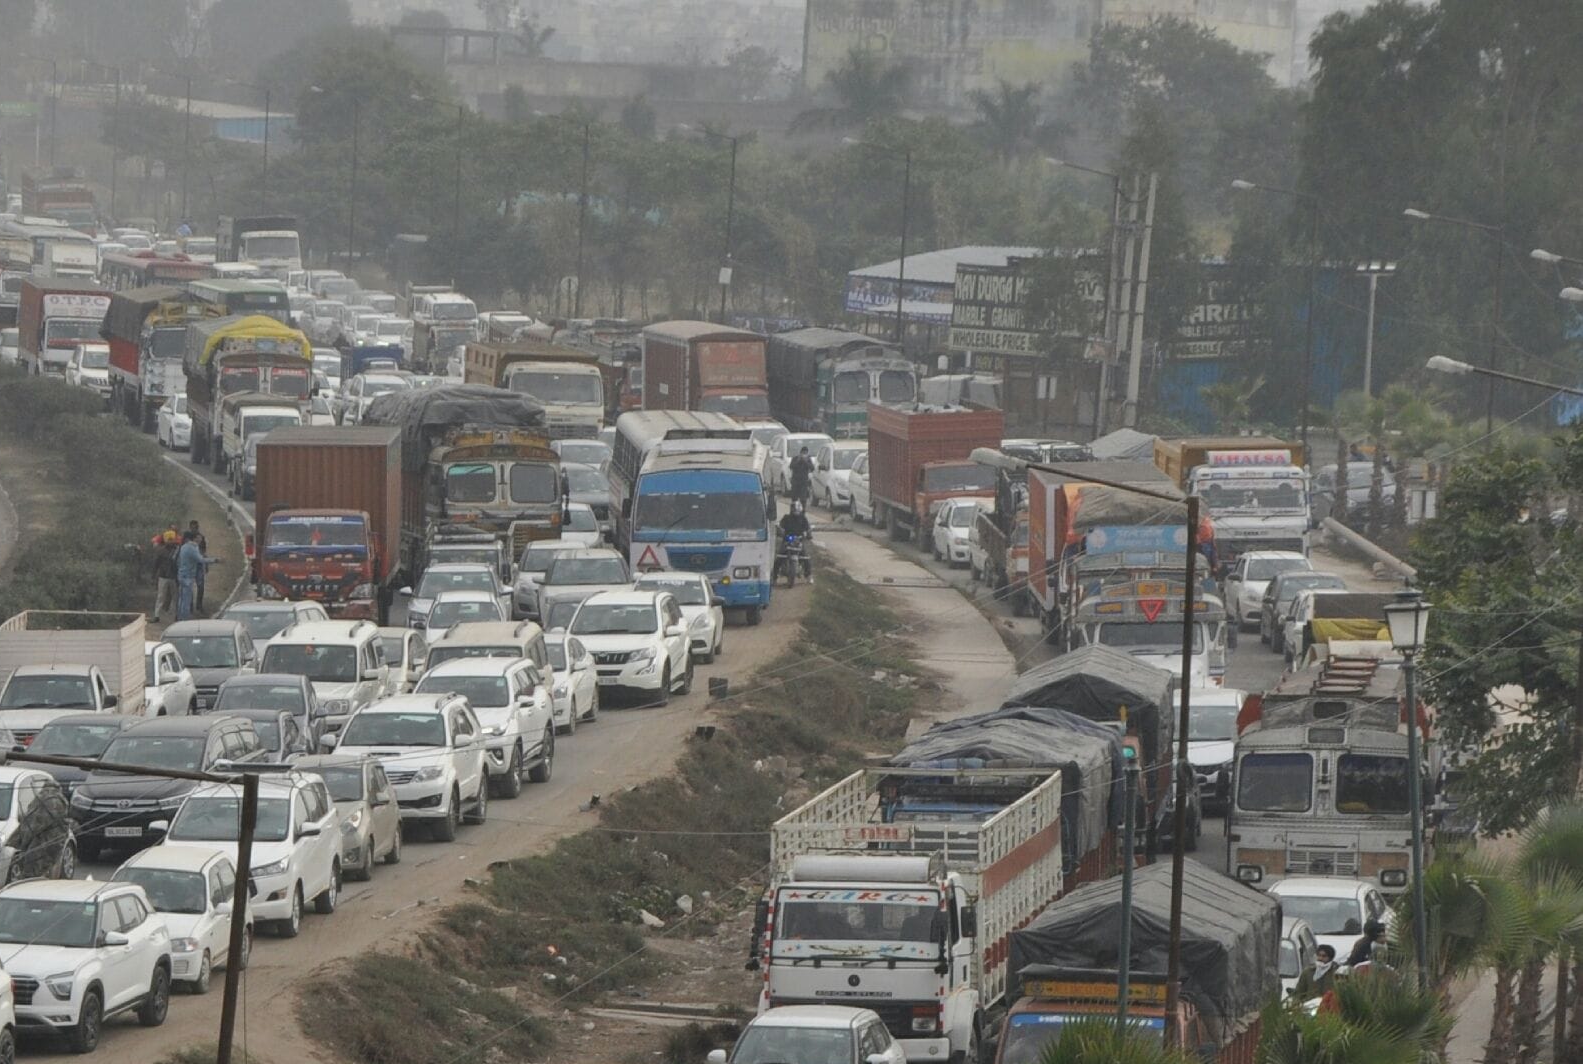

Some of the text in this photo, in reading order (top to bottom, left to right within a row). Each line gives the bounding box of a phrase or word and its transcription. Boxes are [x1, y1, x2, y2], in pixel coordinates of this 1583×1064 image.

[978, 274, 1013, 304] DURGA
[953, 330, 1001, 350] WHOLESALE
[1213, 453, 1287, 465] KHALSA
